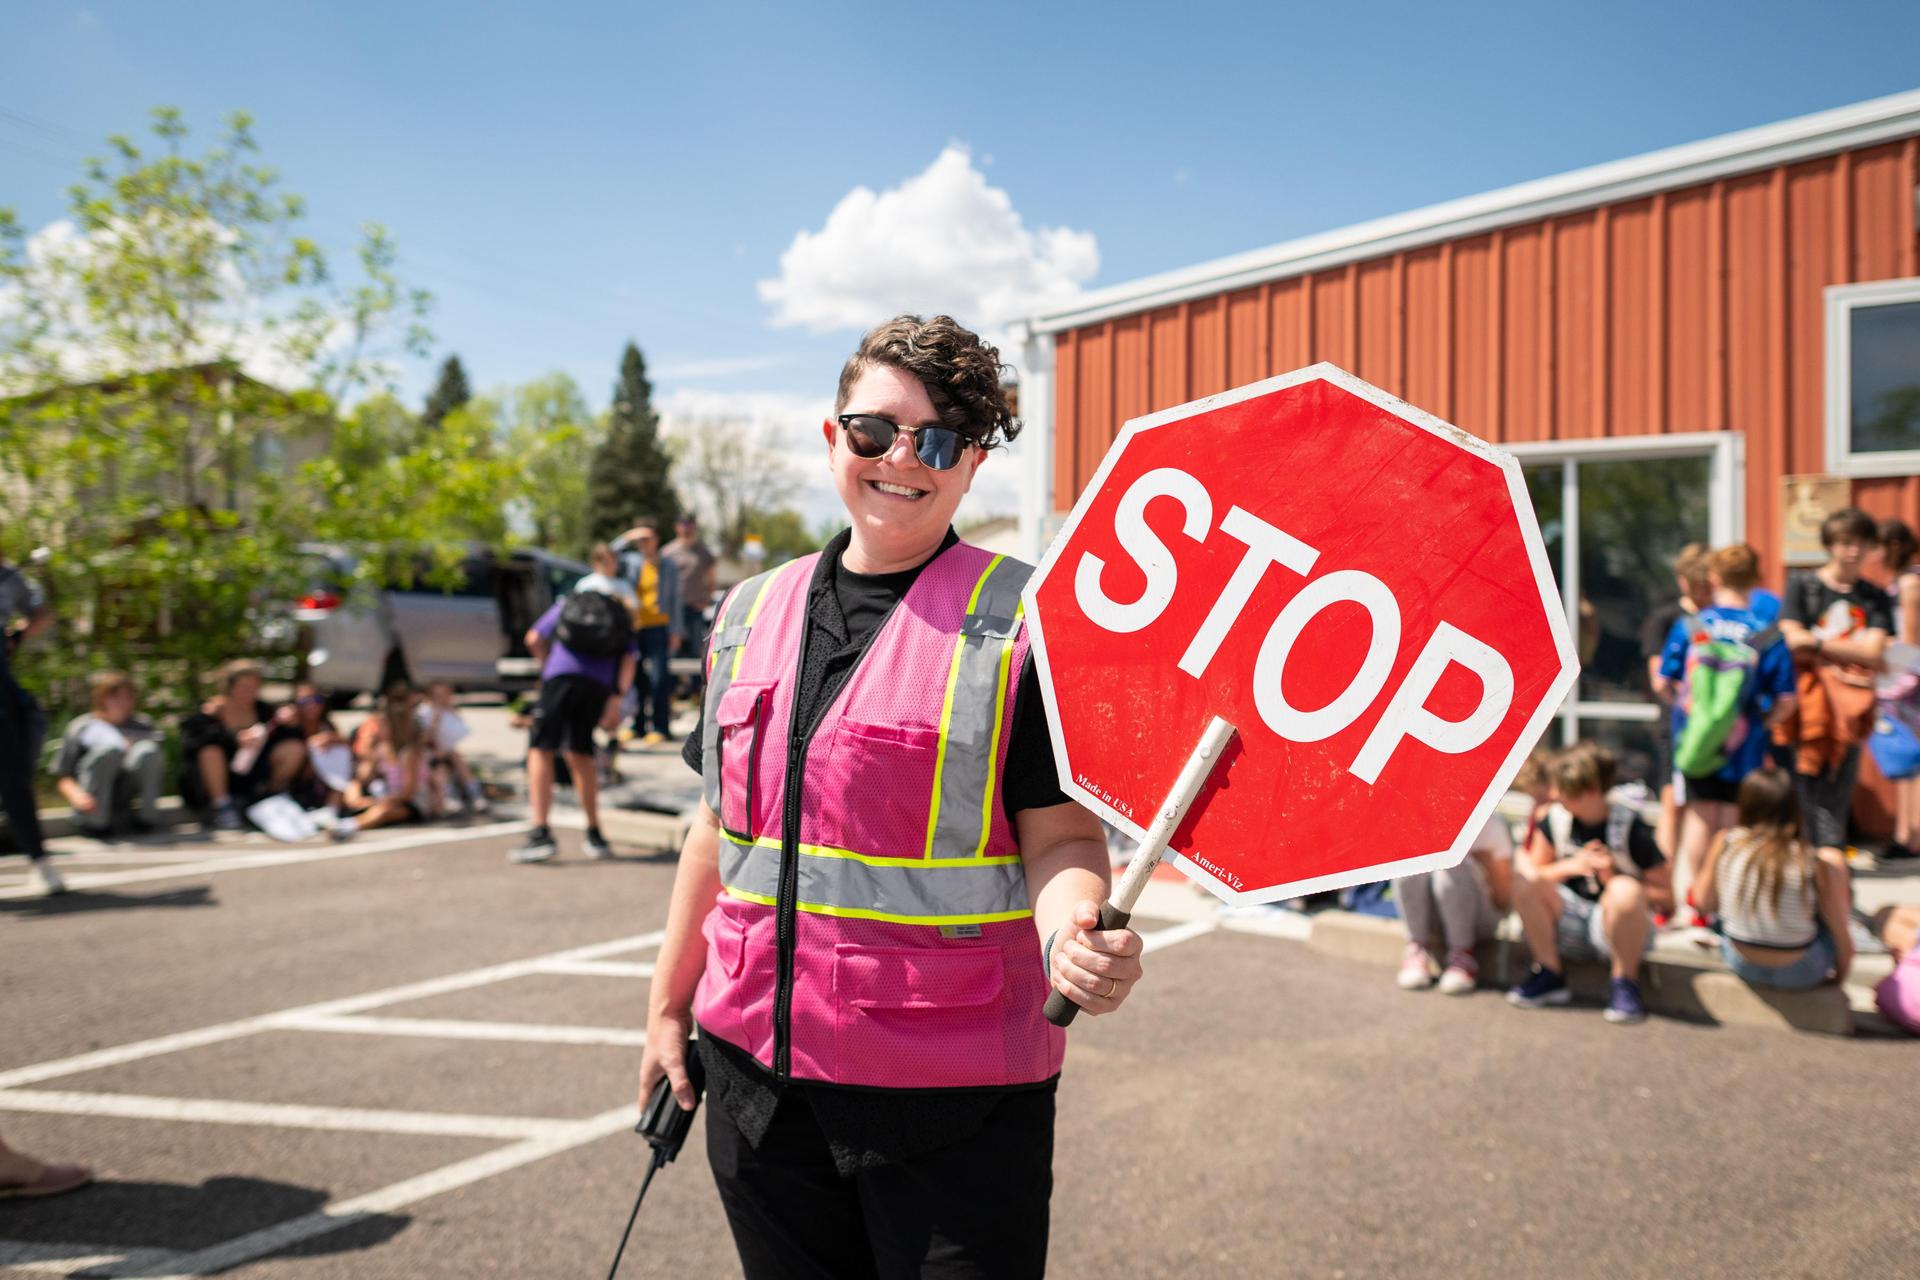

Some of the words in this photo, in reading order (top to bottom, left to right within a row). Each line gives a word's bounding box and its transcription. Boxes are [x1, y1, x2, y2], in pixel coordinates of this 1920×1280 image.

[1075, 468, 1514, 785] STOP
[1076, 774, 1102, 796] Made
[1102, 790, 1113, 803] in
[1113, 798, 1134, 818] USA
[1191, 851, 1244, 891] Ameri-Viz
